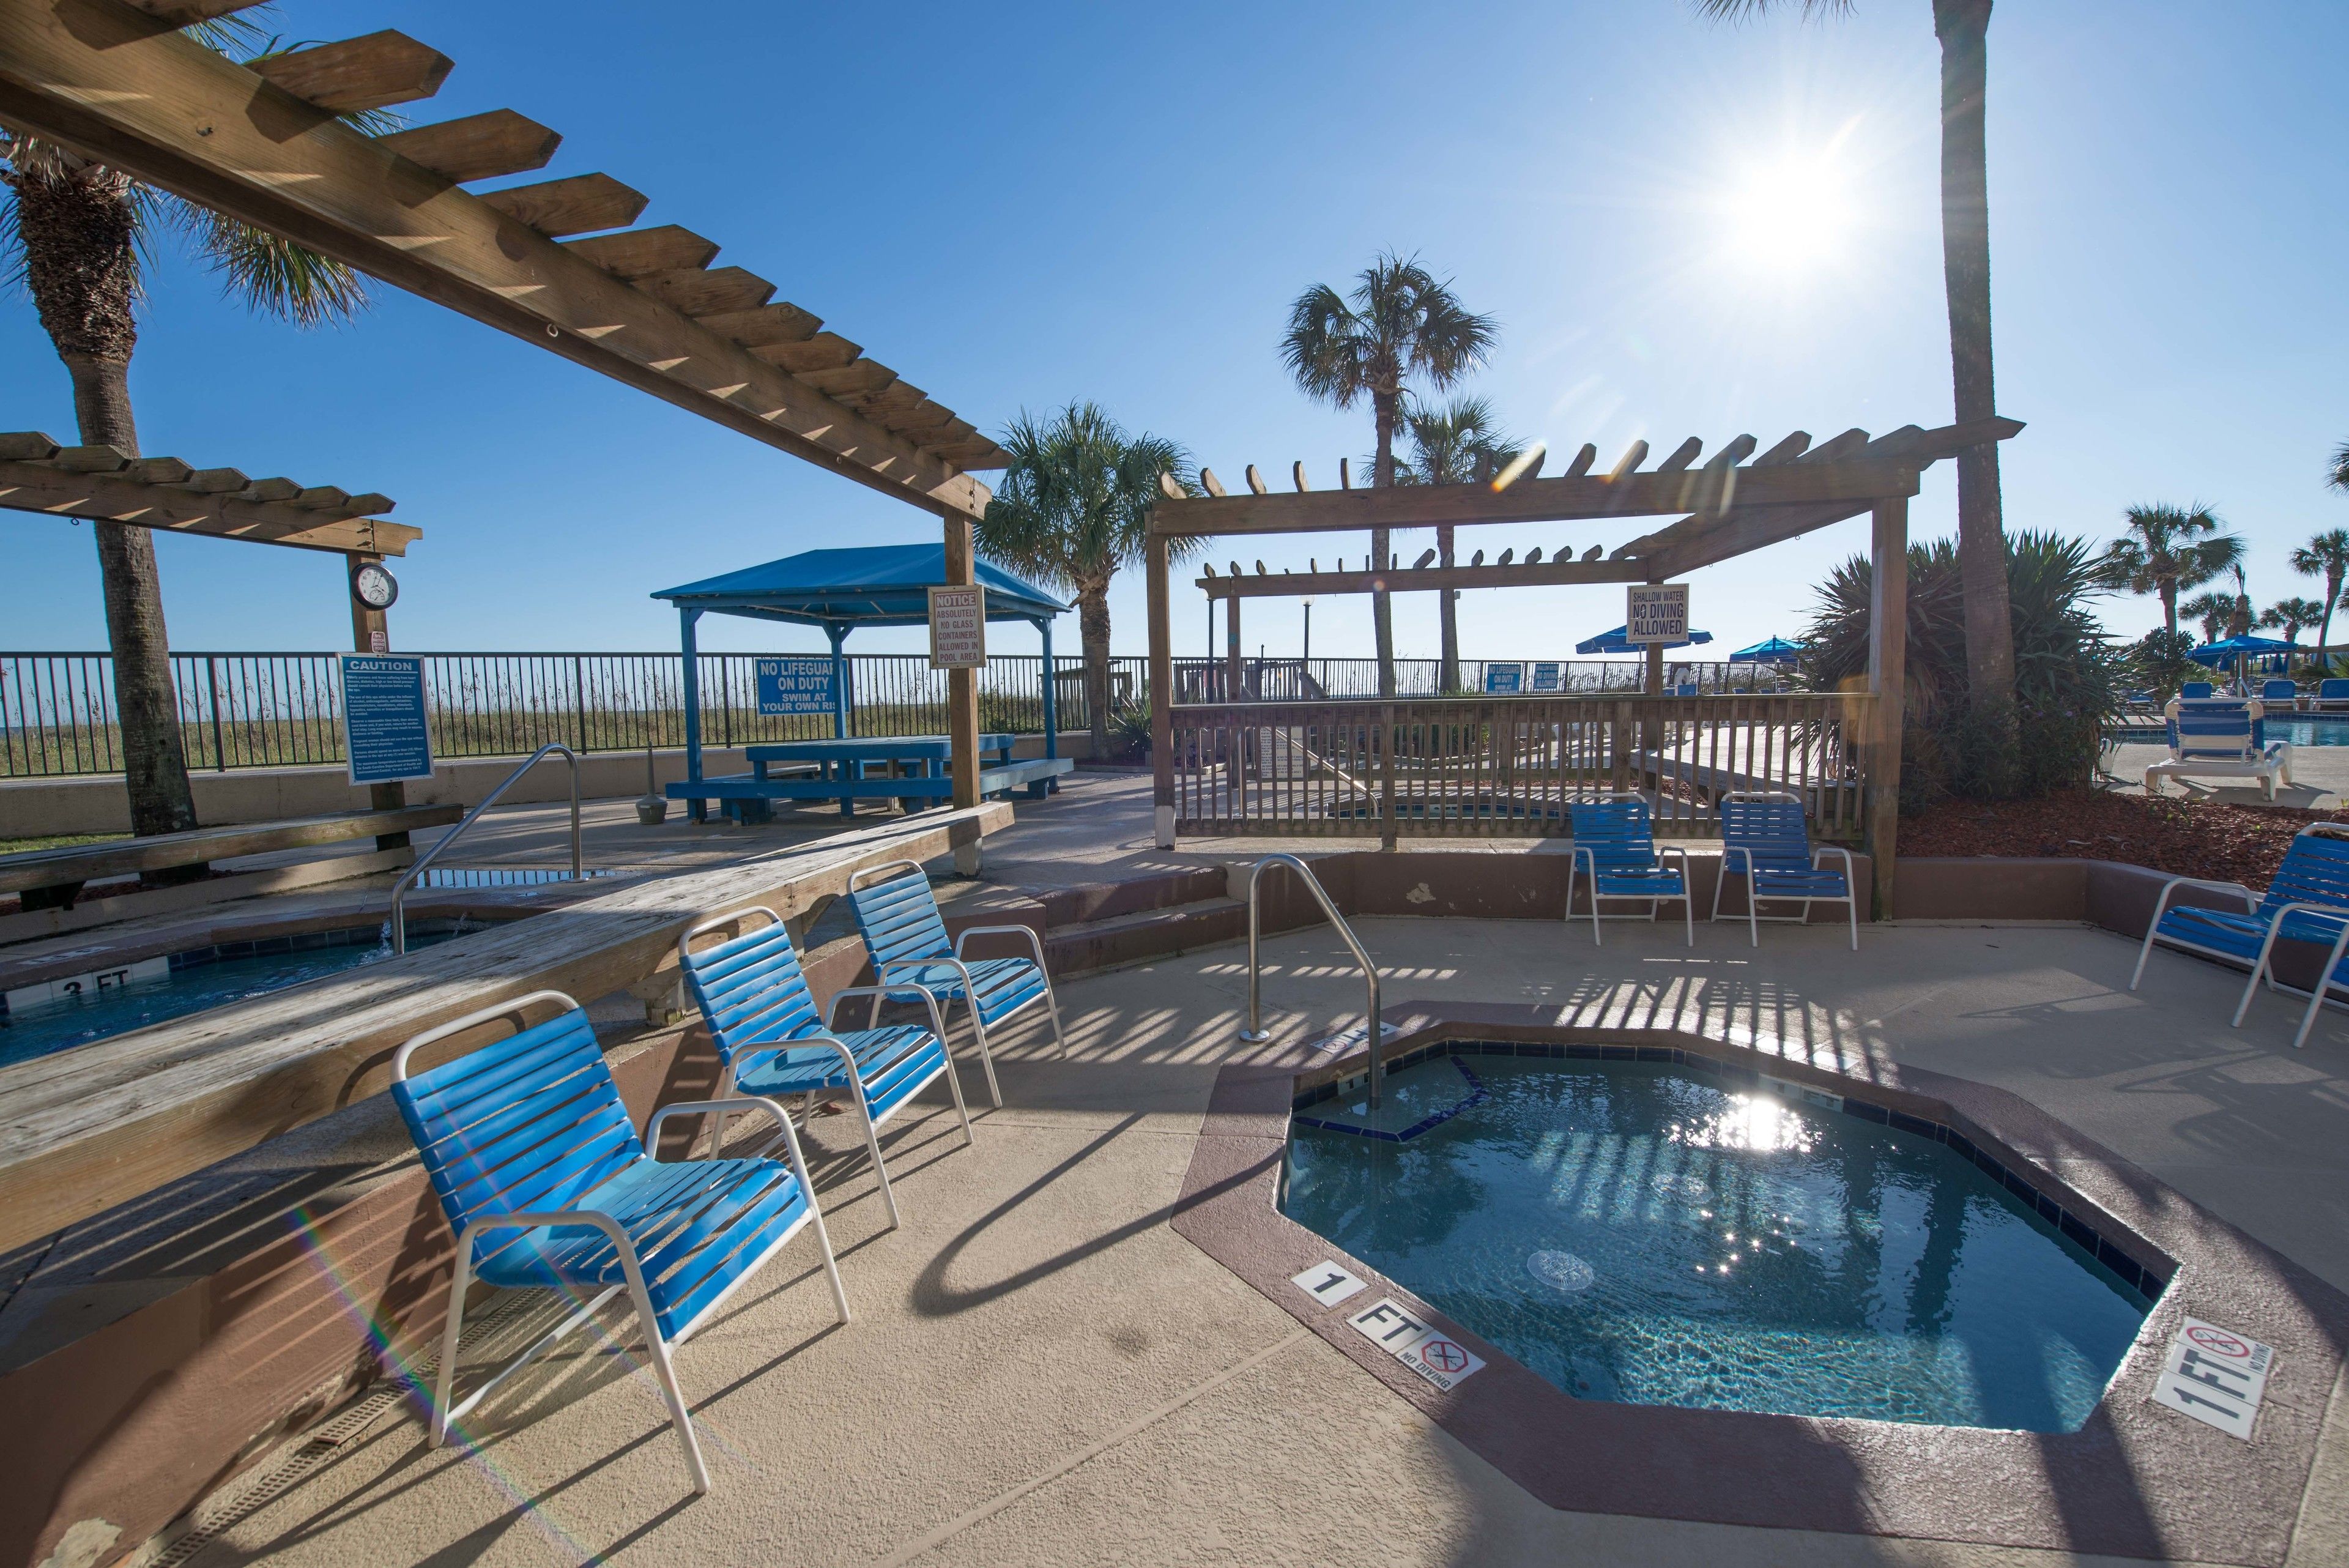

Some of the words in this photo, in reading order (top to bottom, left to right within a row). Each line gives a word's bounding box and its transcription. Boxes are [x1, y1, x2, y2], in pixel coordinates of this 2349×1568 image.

[937, 594, 975, 607] NOTICE
[1633, 592, 1661, 603] SHALLOW
[1663, 591, 1683, 601] WATER
[937, 608, 976, 619] ABSOLUTELY
[1633, 604, 1647, 619] NO
[1650, 603, 1683, 619] DIVING
[952, 620, 973, 628] GLASS
[1633, 620, 1682, 636] ALLOWED
[938, 631, 977, 641] CONTAINERS
[938, 642, 969, 652] ALLOWED
[971, 641, 978, 650] IN
[940, 653, 957, 662] POOL
[960, 652, 978, 661] AREA
[350, 661, 412, 671] CAUTION
[760, 662, 778, 676] NO
[1497, 666, 1520, 674] LIFEGUARD
[777, 677, 795, 690] ON
[798, 677, 829, 690] DUTY
[782, 693, 811, 702] SWIM
[814, 693, 827, 701] AT
[762, 703, 793, 712] YOUR
[795, 702, 819, 711] OWN
[97, 970, 128, 990] FT
[1313, 1273, 1347, 1293] 1
[1357, 1303, 1423, 1342] FT
[2252, 1343, 2270, 1363] DIVING
[1399, 1351, 1417, 1364] NO
[1415, 1361, 1452, 1388] DIVING
[2248, 1360, 2265, 1372] NO
[2178, 1348, 2251, 1399] FT
[2173, 1386, 2241, 1419] 1
